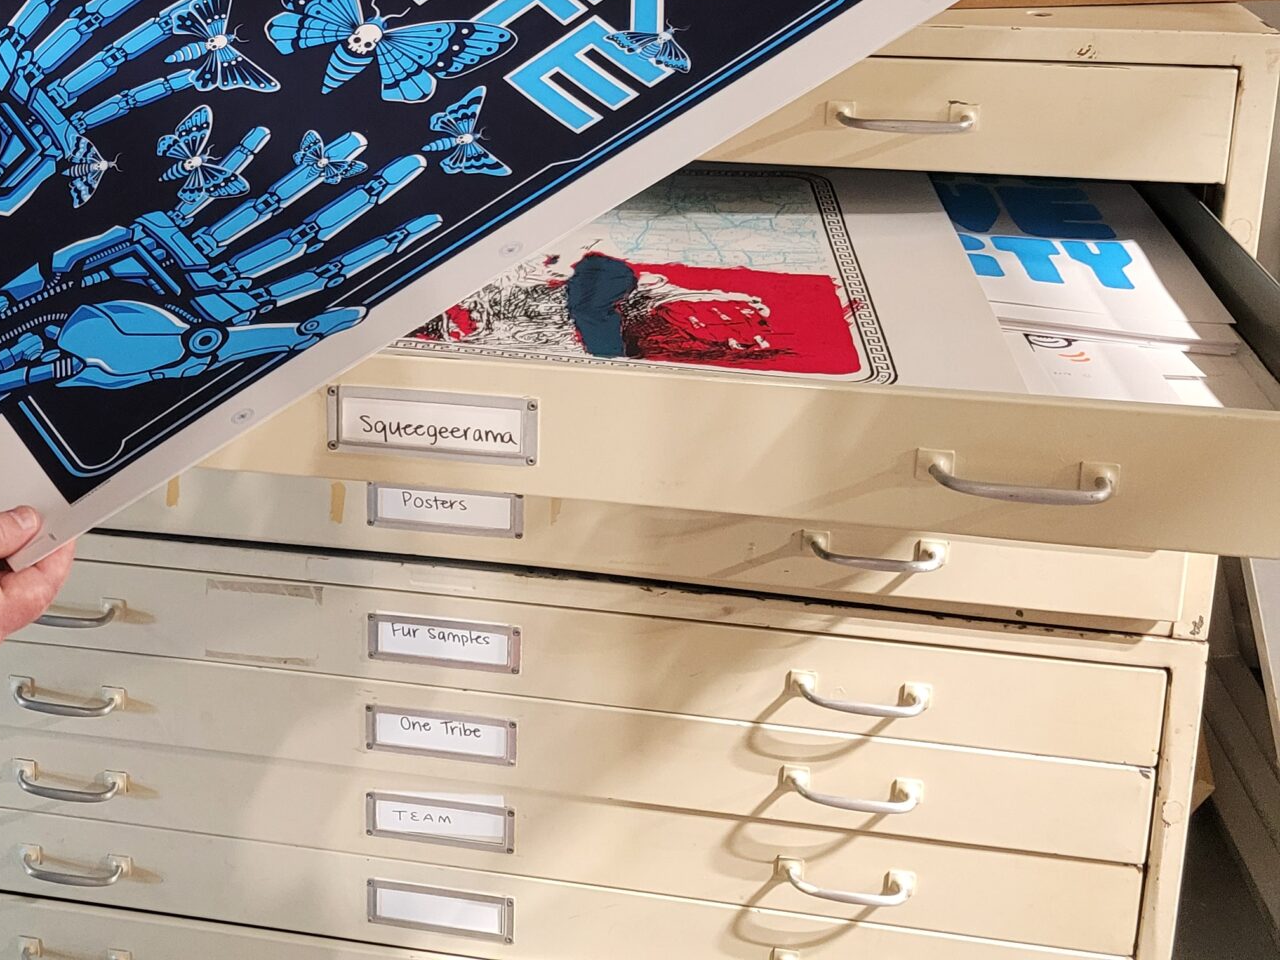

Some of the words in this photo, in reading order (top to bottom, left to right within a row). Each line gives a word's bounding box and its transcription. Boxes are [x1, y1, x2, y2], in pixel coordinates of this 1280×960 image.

[359, 414, 518, 446] Squeegeerama
[402, 490, 468, 511] Posters
[391, 622, 420, 639] Fur
[400, 716, 432, 733] One
[440, 720, 482, 739] Tribe
[392, 810, 452, 825] TEAM
